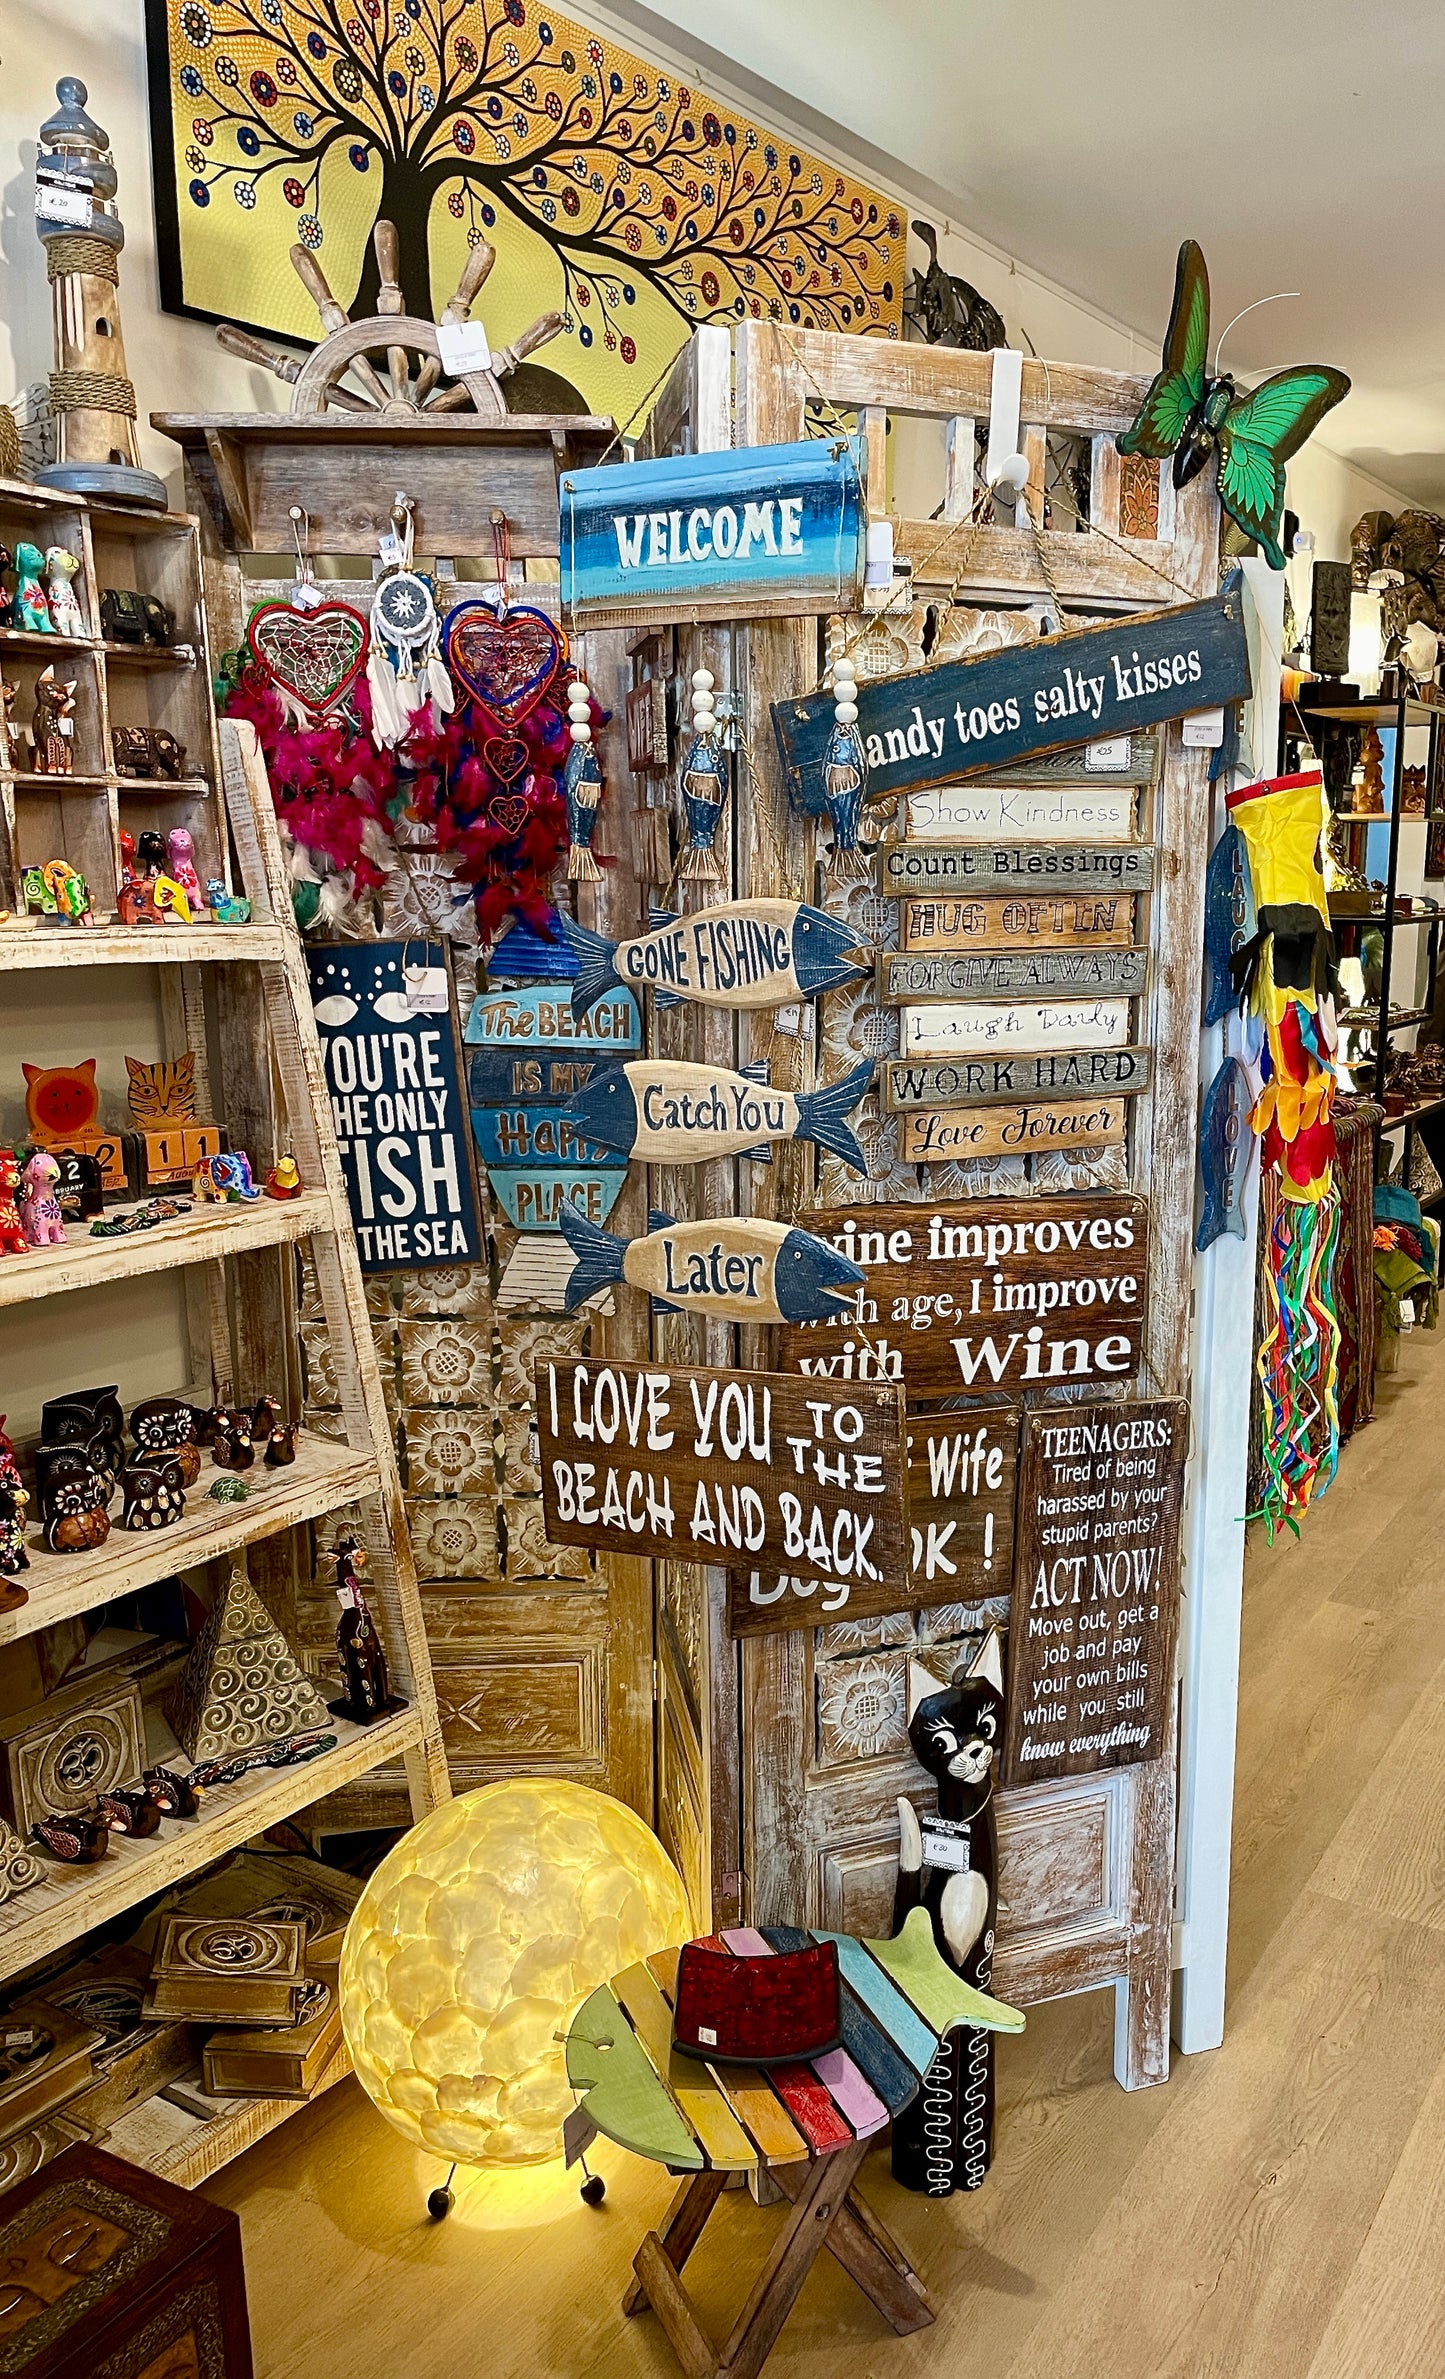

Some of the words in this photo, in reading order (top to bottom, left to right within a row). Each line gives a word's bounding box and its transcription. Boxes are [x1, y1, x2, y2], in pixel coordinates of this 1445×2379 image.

[614, 497, 803, 568] WELCOME
[866, 706, 945, 768] andy
[954, 696, 1021, 742] toes
[1034, 668, 1104, 723] salty
[1111, 649, 1201, 702] kisses
[910, 793, 990, 829] Show
[999, 793, 1120, 828] Kindness
[887, 851, 976, 876] Count
[994, 850, 1139, 878] Blessings
[910, 904, 987, 939] HUG
[1002, 900, 1119, 935] OFTEN
[1231, 848, 1247, 957] LAUG
[627, 930, 688, 985] GONE
[697, 919, 790, 990] FISHING
[888, 957, 1013, 994] FORGIVE
[1020, 951, 1138, 986] ALWAYS
[479, 1001, 534, 1038] The
[538, 1002, 631, 1039] BEACH
[912, 1011, 1024, 1040] Laugh
[1037, 1001, 1119, 1034] Daily
[513, 1060, 542, 1096] IS
[550, 1062, 596, 1095] MY
[891, 1060, 1014, 1100] WORK
[1036, 1051, 1137, 1085] HARD
[331, 1095, 372, 1136] HE
[375, 1089, 448, 1134] ONLY
[643, 1085, 727, 1132] Catch
[731, 1086, 785, 1131] You
[912, 1115, 988, 1153] Love
[1002, 1106, 1118, 1145] Forever
[1222, 1081, 1240, 1213] LOVE
[55, 1183, 84, 1195] BRUARY
[67, 1161, 80, 1180] 2
[516, 1182, 601, 1223] PLACE
[358, 1223, 411, 1261] THE
[414, 1220, 469, 1257] SEA
[826, 1219, 913, 1266] ine
[928, 1216, 1134, 1266] improves
[664, 1240, 765, 1298] Later
[891, 1293, 963, 1330] age,
[969, 1278, 981, 1315] I
[992, 1273, 1137, 1317] improve
[798, 1340, 905, 1381] with
[950, 1326, 1132, 1385] Wine
[548, 1361, 559, 1438] I
[573, 1364, 674, 1450] LOVE
[689, 1376, 771, 1465] YOU
[805, 1400, 864, 1442] TO
[1041, 1418, 1172, 1459] TEENAGERS:
[786, 1435, 887, 1493] THE
[927, 1427, 1003, 1498] Wife
[1052, 1460, 1091, 1485] Tired
[1096, 1458, 1112, 1480] of
[1116, 1456, 1156, 1478] being
[552, 1459, 675, 1538] BEACH
[689, 1479, 765, 1551] AND
[778, 1491, 884, 1583] BACK.
[1037, 1489, 1106, 1517] harassed
[1111, 1488, 1130, 1511] by
[1134, 1486, 1168, 1509] your
[1041, 1519, 1090, 1546] stupid
[1094, 1512, 1158, 1544] parents?
[1030, 1555, 1088, 1610] ACT
[1091, 1546, 1163, 1602] NOW!
[1028, 1616, 1074, 1639] Move
[1079, 1609, 1112, 1631] out,
[1118, 1604, 1144, 1630] get
[1149, 1605, 1159, 1621] a
[1041, 1642, 1070, 1670] job
[1075, 1637, 1107, 1661] and
[1112, 1635, 1142, 1659] pay
[1032, 1675, 1072, 1701] your
[1076, 1668, 1110, 1689] own
[1116, 1660, 1148, 1683] bills
[1023, 1701, 1067, 1726] while
[1079, 1699, 1106, 1722] you
[1116, 1686, 1145, 1712] still
[1019, 1735, 1066, 1762] know
[1069, 1720, 1151, 1756] everything
